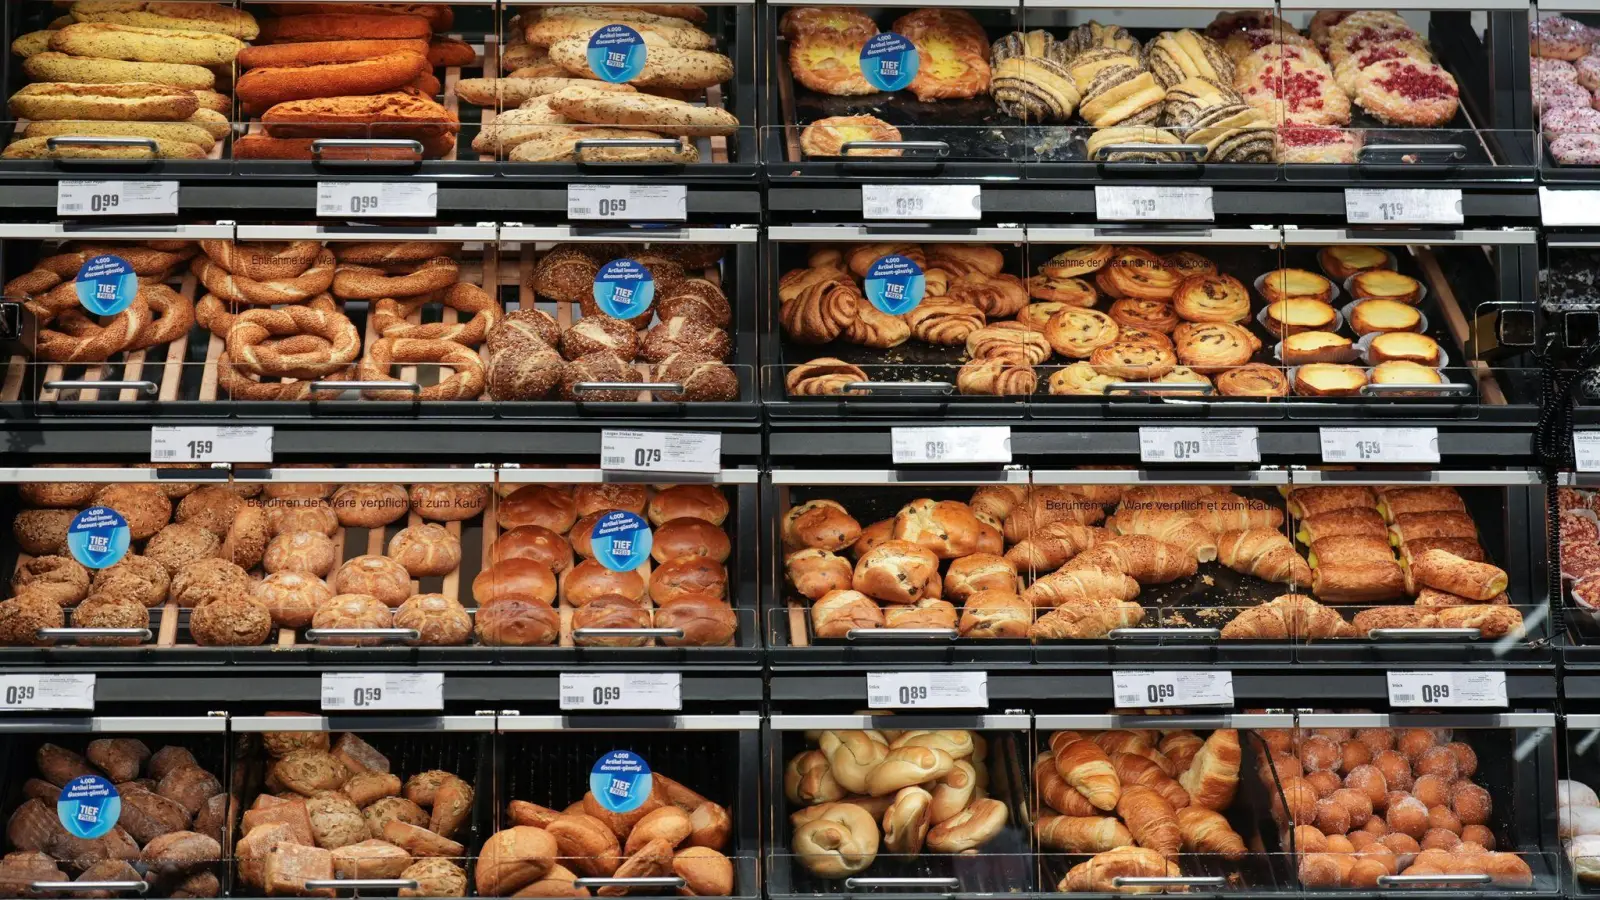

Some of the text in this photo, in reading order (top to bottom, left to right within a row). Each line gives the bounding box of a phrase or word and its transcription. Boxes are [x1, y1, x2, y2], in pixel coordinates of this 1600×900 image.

[608, 52, 626, 62] TIEF
[881, 60, 899, 70] TIEF
[91, 194, 119, 212] 0.99
[350, 196, 378, 212] 0.99
[599, 199, 626, 216] 0.69
[98, 284, 117, 293] TIEF
[615, 287, 633, 298] TIEF
[886, 283, 905, 293] TIEF
[187, 440, 213, 459] 1.59
[1174, 440, 1200, 458] 0.79
[634, 448, 661, 467] 0.79
[304, 497, 322, 508] der
[328, 498, 356, 508] Ware
[426, 499, 450, 508] zum
[1124, 500, 1153, 510] Ware
[1221, 502, 1244, 511] zum
[90, 535, 109, 545] TIEF
[613, 540, 632, 549] TIEF
[6, 686, 34, 704] 0.39
[353, 687, 382, 706] 0.59
[592, 687, 620, 705] 0.69
[899, 686, 927, 704] 0.89
[1147, 684, 1174, 703] 0.69
[1422, 684, 1449, 703] 0.89
[612, 778, 631, 790] TIEF
[80, 804, 99, 816] TIEF
